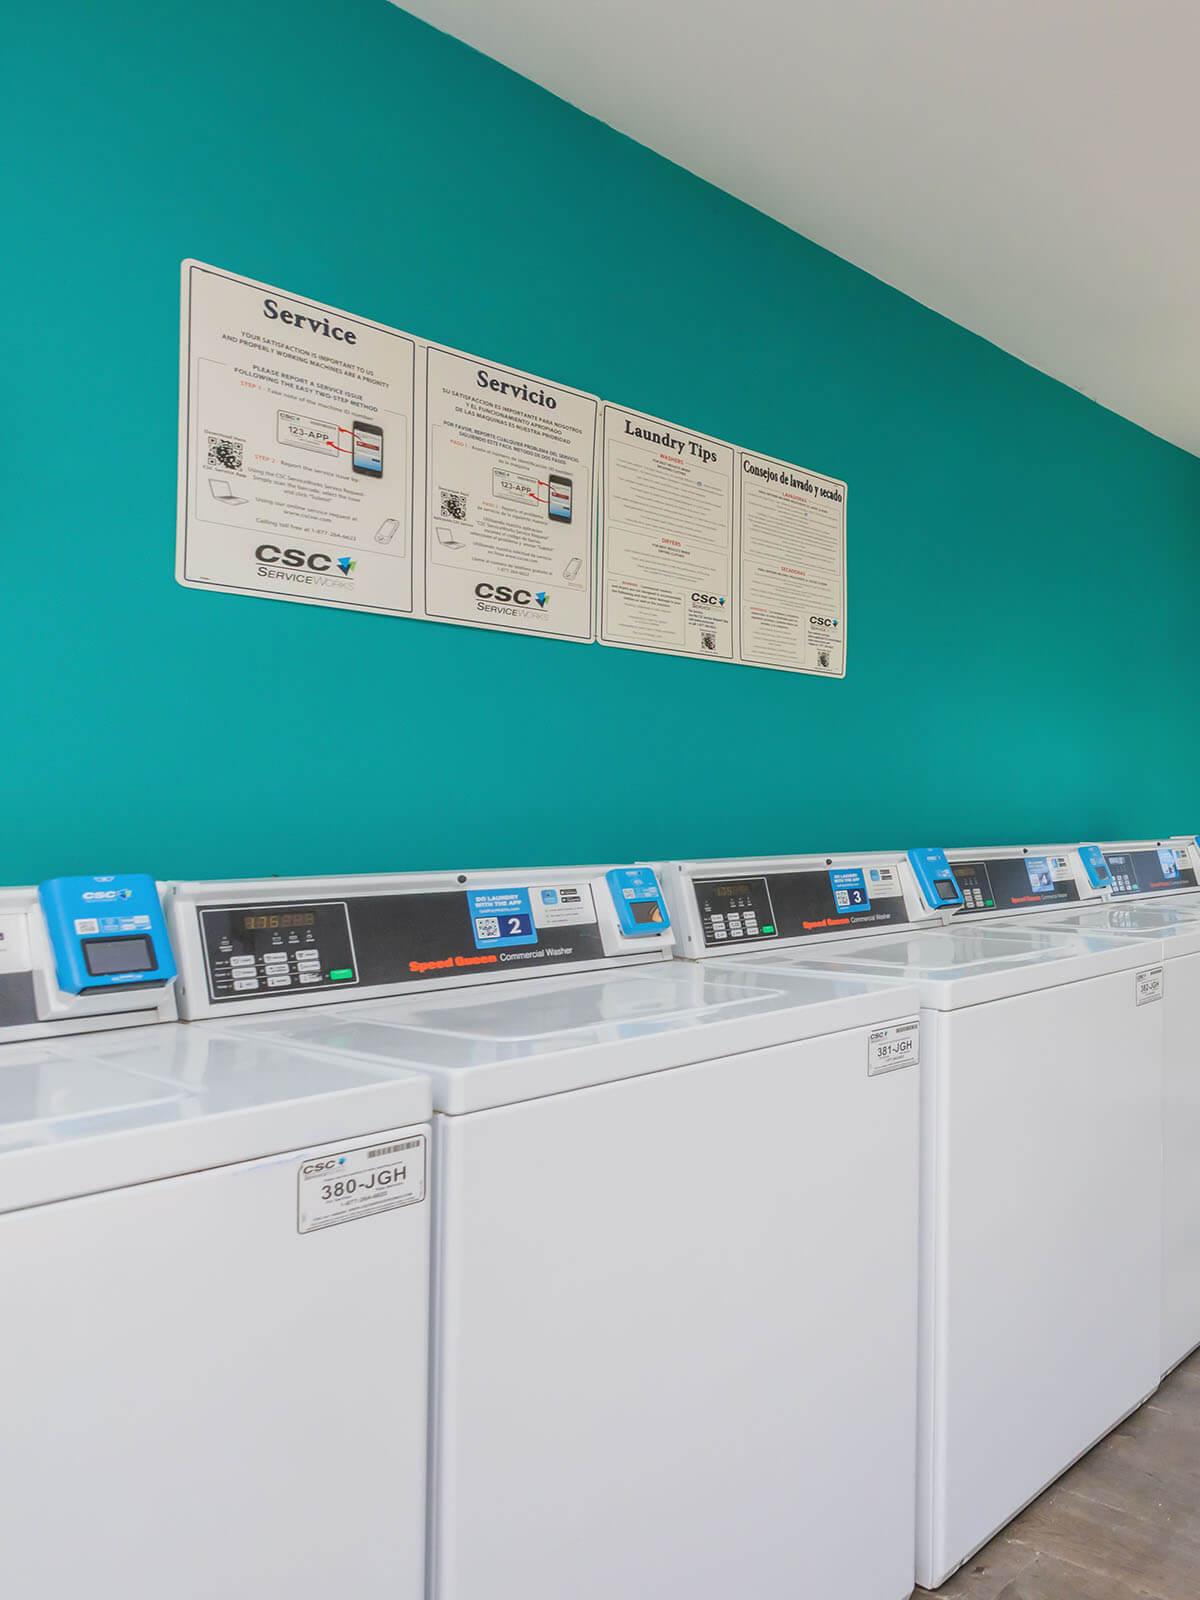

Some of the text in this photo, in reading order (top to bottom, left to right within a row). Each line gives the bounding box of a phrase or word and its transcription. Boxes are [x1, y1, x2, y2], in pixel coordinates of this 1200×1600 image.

[263, 298, 357, 346] Service
[222, 333, 237, 343] AND
[239, 338, 274, 354] PROPERLY
[276, 349, 307, 364] WORKING
[310, 359, 342, 374] MACHINES
[344, 369, 355, 378] ARE
[362, 375, 388, 388] PRIORITY
[241, 330, 260, 342] YOUR
[262, 337, 309, 356] SATISFACTION
[318, 353, 354, 370] IMPORTANT
[356, 365, 364, 373] TO
[234, 367, 278, 384] FOLLOWING
[280, 380, 293, 388] THE
[296, 384, 312, 394] EASY
[350, 399, 377, 411] METHOD
[252, 364, 278, 376] PLEASE
[281, 372, 307, 385] REPORT
[316, 382, 342, 394] SERVICE
[344, 390, 362, 400] ISSUE
[477, 370, 557, 410] Servicio
[502, 405, 537, 421] IMPORTANTE
[539, 417, 553, 425] PARA
[554, 421, 582, 434] NOSOTROS
[288, 425, 328, 442] 123-APP
[624, 419, 718, 463] Laundry Tips
[743, 459, 843, 503] Consejos de lavado y secado
[255, 544, 332, 572] CSC
[475, 583, 531, 604] CSC
[691, 592, 718, 606] CSC
[809, 616, 831, 627] CSC
[82, 890, 117, 900] CSC
[853, 890, 862, 903] 3
[508, 917, 522, 935] 2
[409, 946, 574, 973] Speed Queen Commercial Washer
[871, 1031, 884, 1040] CSC
[877, 1040, 912, 1057] 381-JGH
[303, 1160, 336, 1174] CSC
[321, 1166, 406, 1200] 380-JGH
